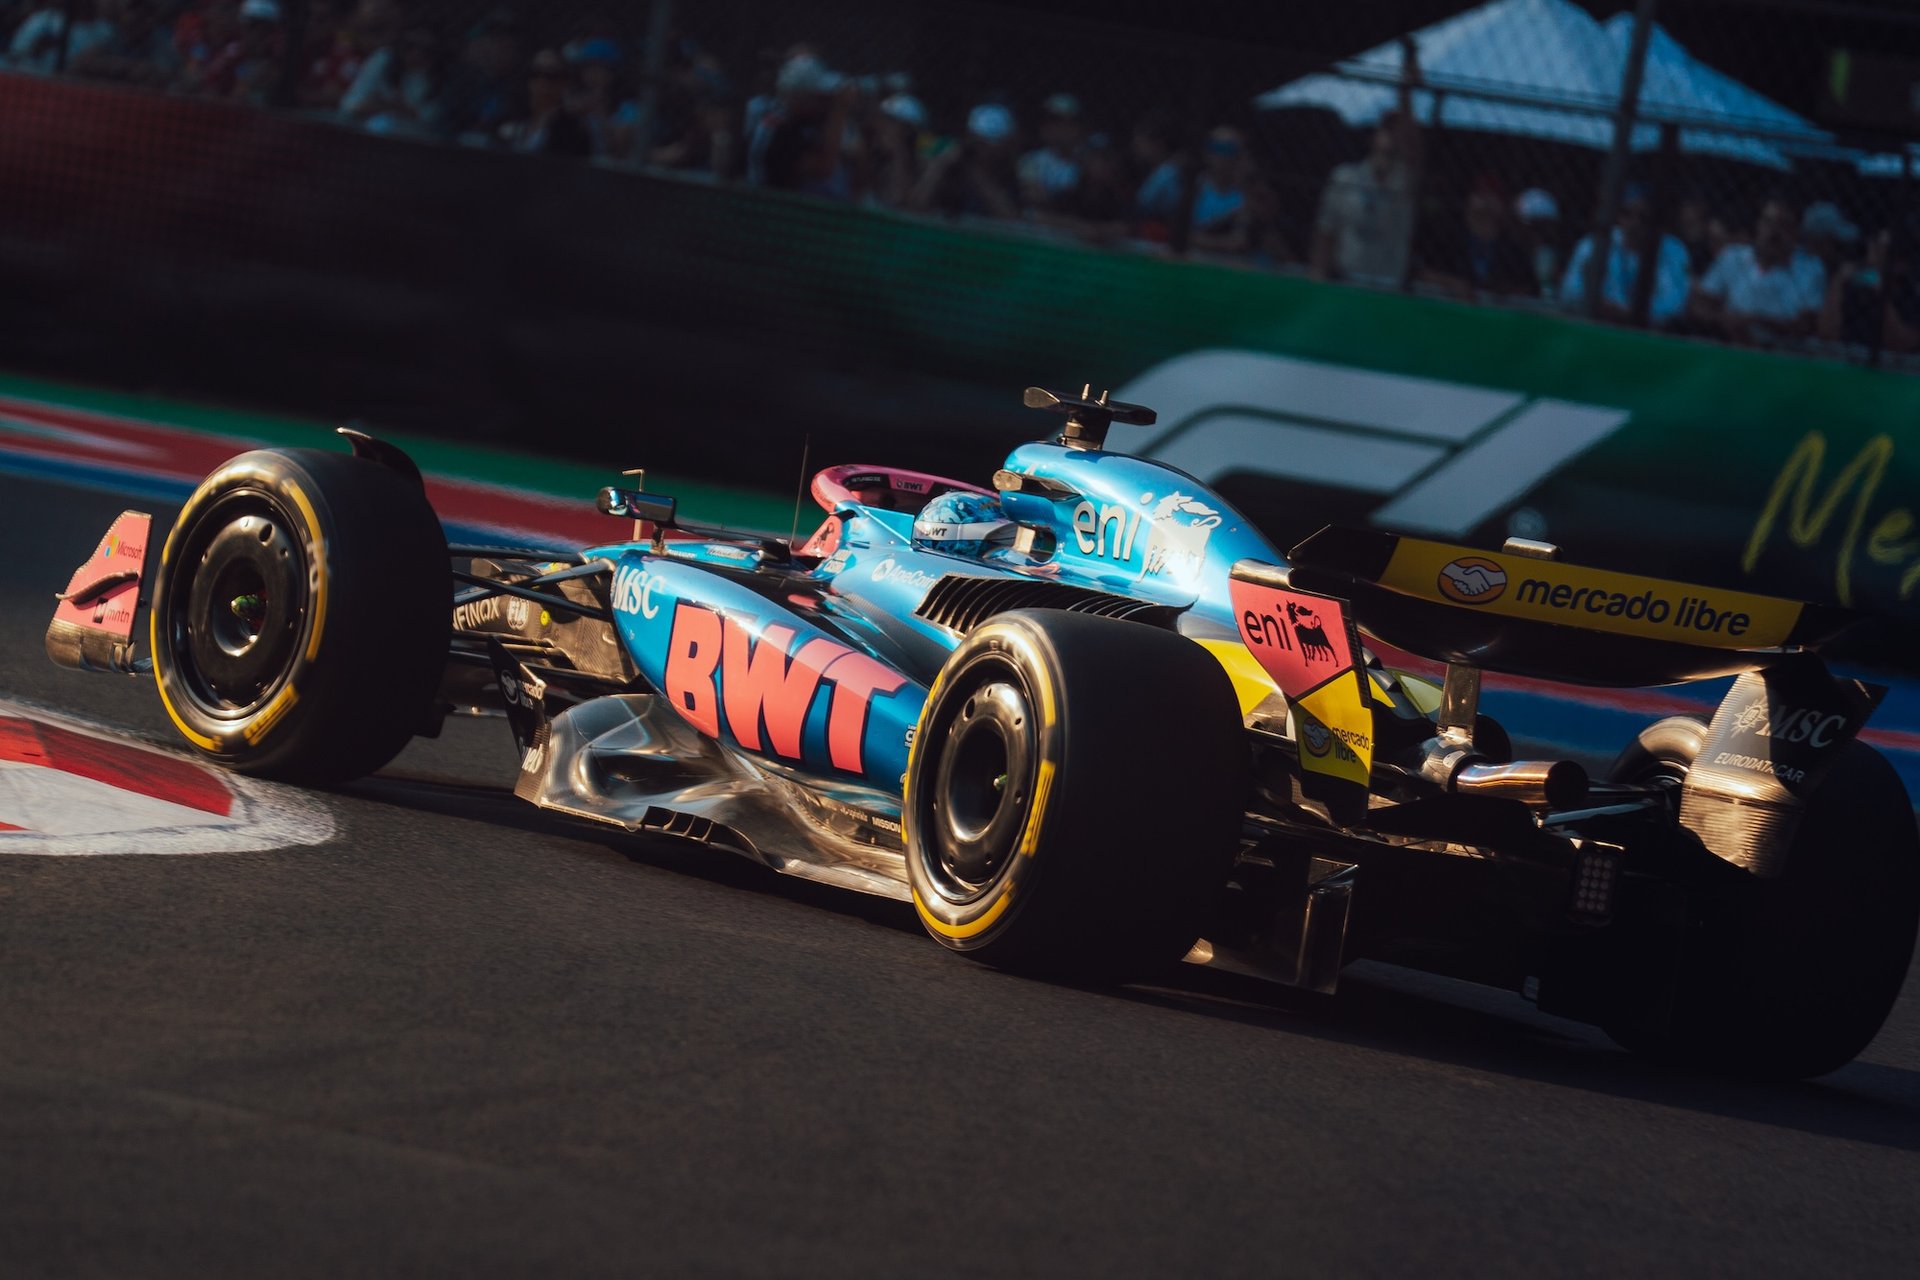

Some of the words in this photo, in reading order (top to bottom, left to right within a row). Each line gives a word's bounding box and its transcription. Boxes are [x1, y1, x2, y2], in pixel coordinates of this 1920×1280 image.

[1072, 492, 1154, 561] eni
[1742, 430, 1920, 608] Me
[116, 541, 143, 560] Microsoft
[612, 565, 667, 620] MSC
[1515, 578, 1670, 624] mercado
[1673, 597, 1750, 636] libre
[1243, 603, 1293, 651] eni
[664, 602, 907, 775] BWT
[1331, 726, 1370, 751] mercado
[1334, 738, 1357, 763] libre
[1755, 704, 1847, 749] MSC
[1714, 752, 1806, 784] EURODATACAR
